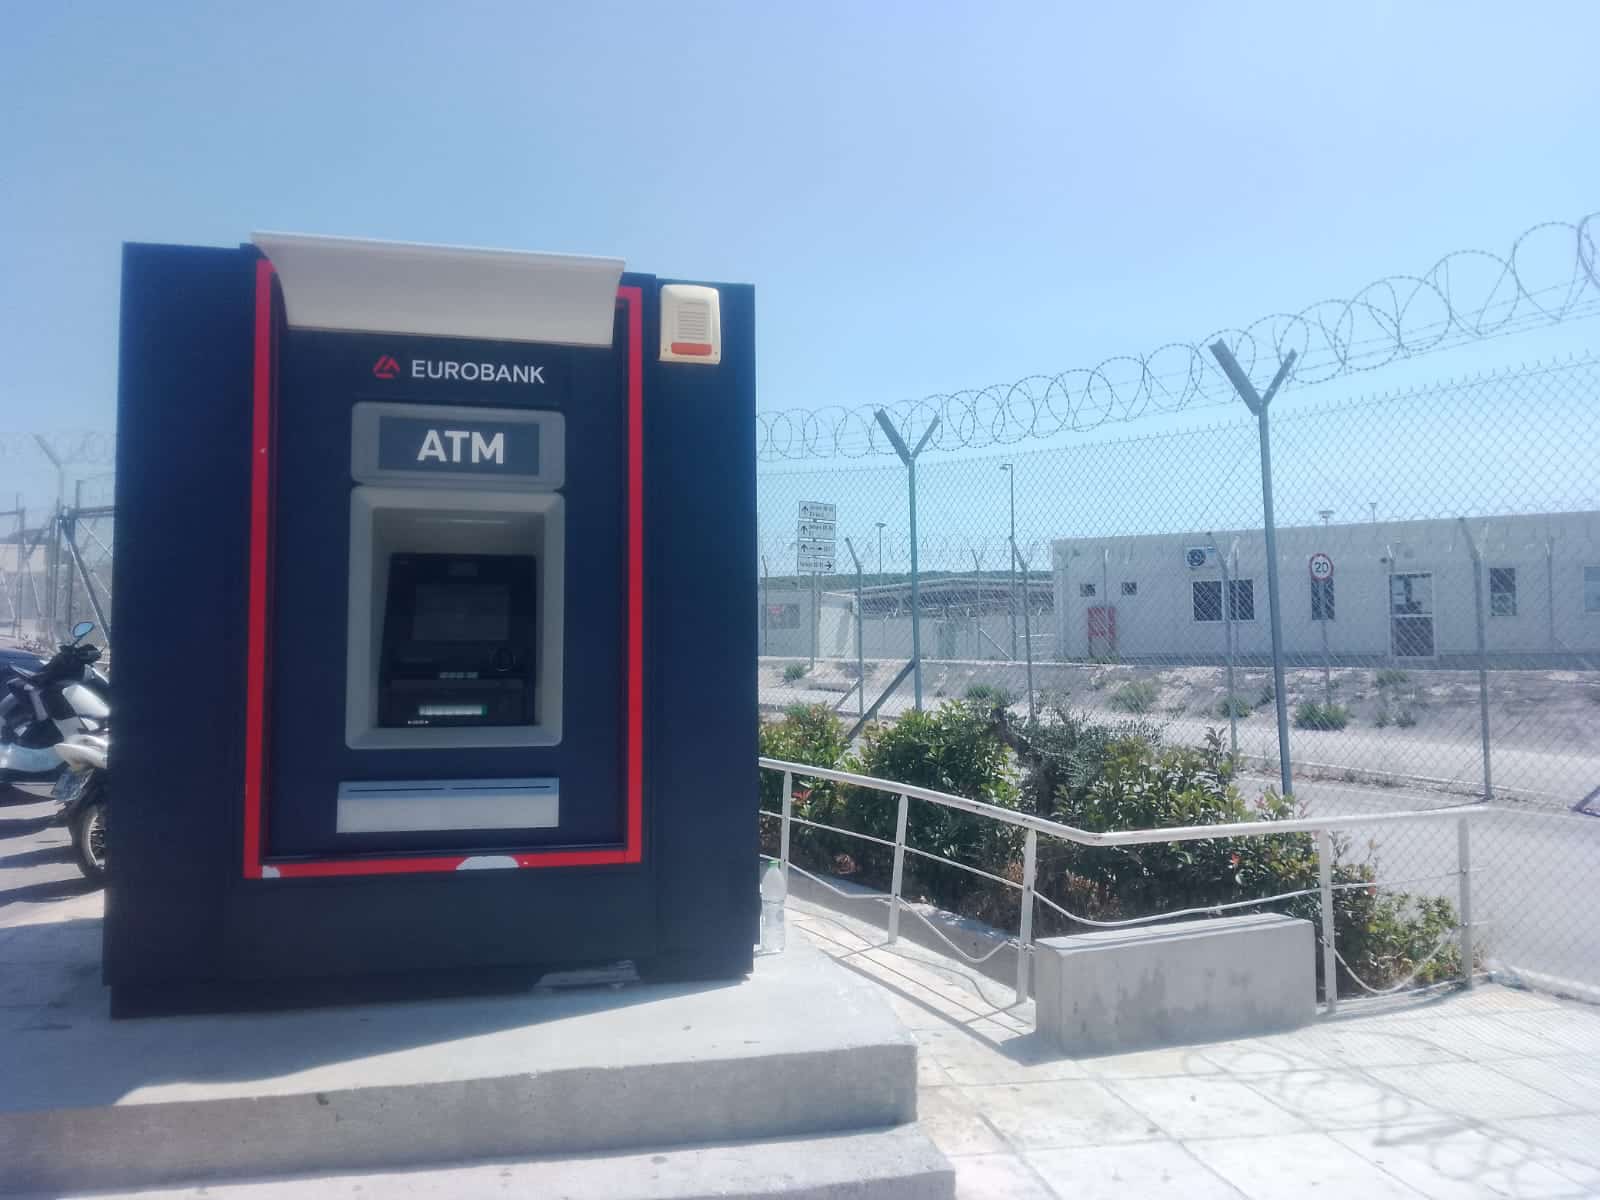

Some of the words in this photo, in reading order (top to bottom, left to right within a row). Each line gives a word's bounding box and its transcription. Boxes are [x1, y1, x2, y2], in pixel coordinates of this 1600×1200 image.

[411, 359, 545, 384] EUROBANK
[416, 429, 505, 464] ATM
[1314, 561, 1329, 573] 20
